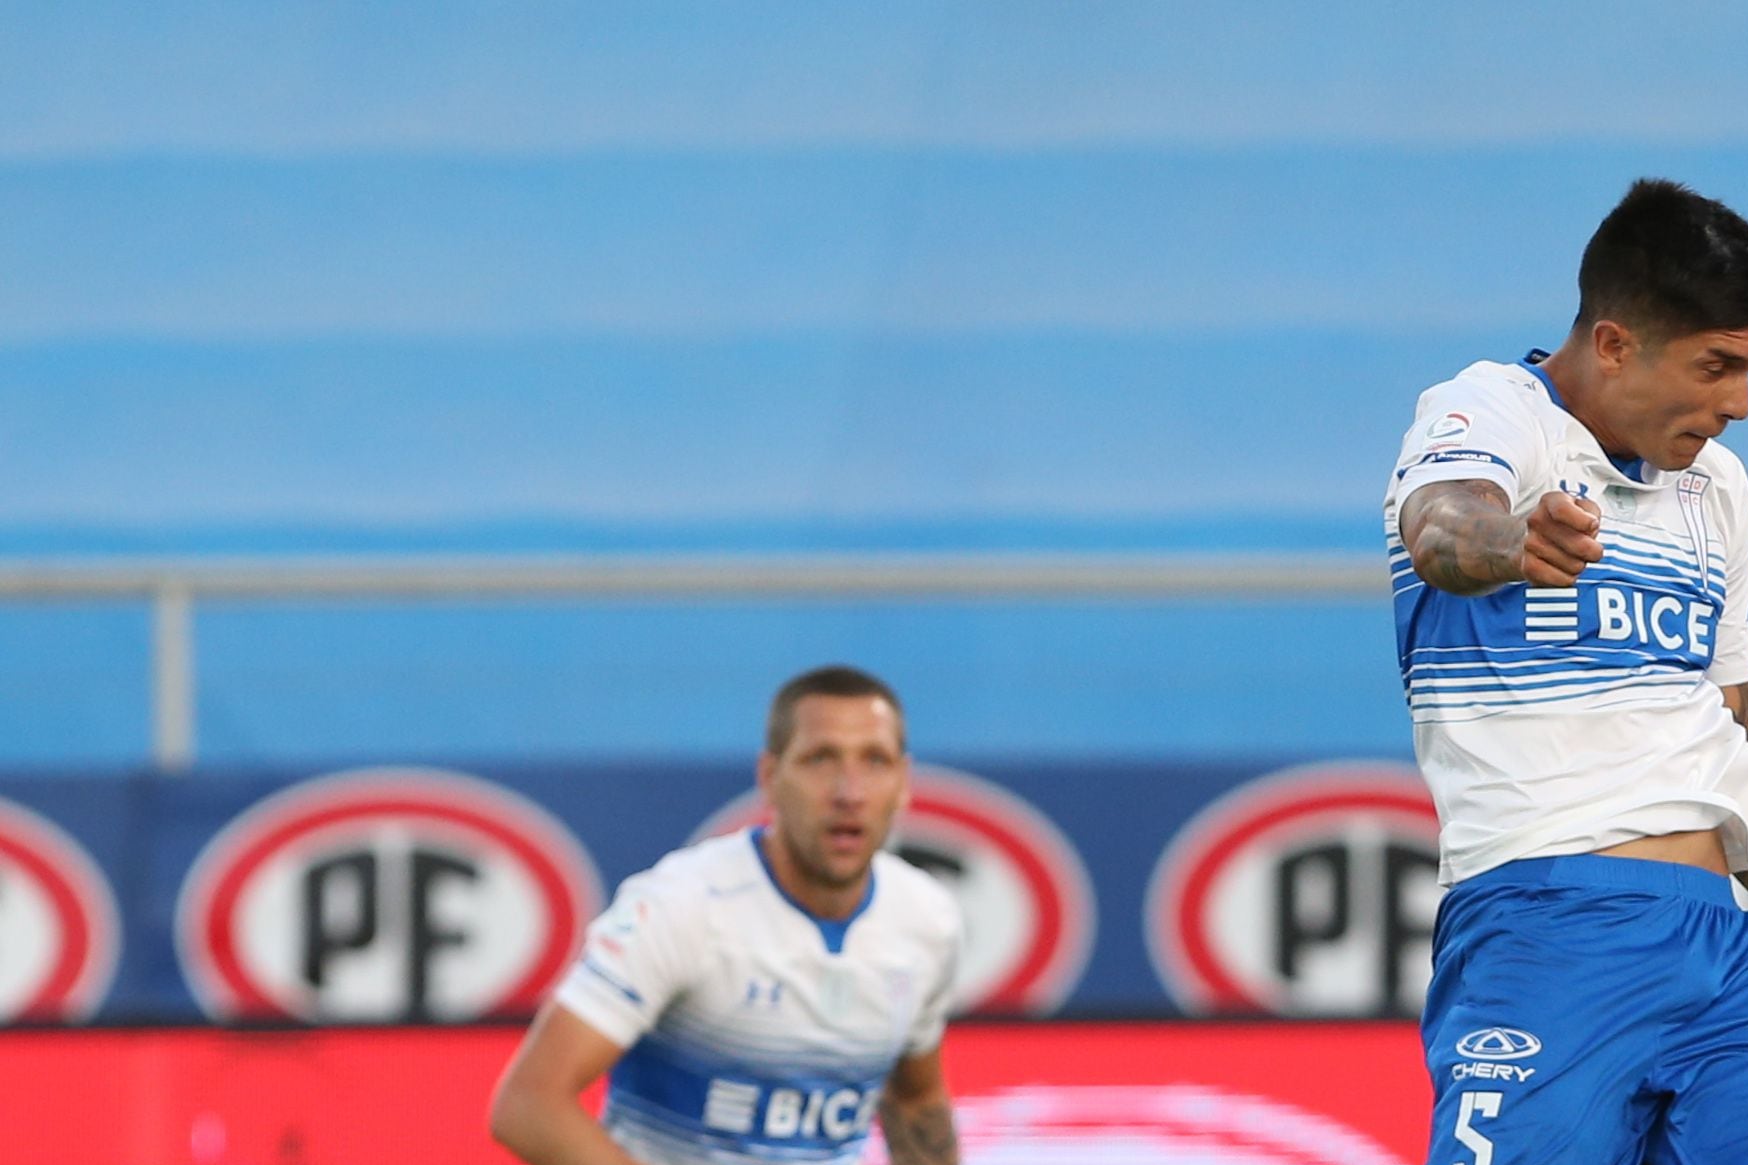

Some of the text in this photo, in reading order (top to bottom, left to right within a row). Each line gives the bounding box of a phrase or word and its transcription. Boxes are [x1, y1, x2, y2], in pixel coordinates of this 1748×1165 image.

[1597, 587, 1715, 657] BICE
[303, 850, 480, 1020] PF
[1452, 1062, 1536, 1082] CHERY
